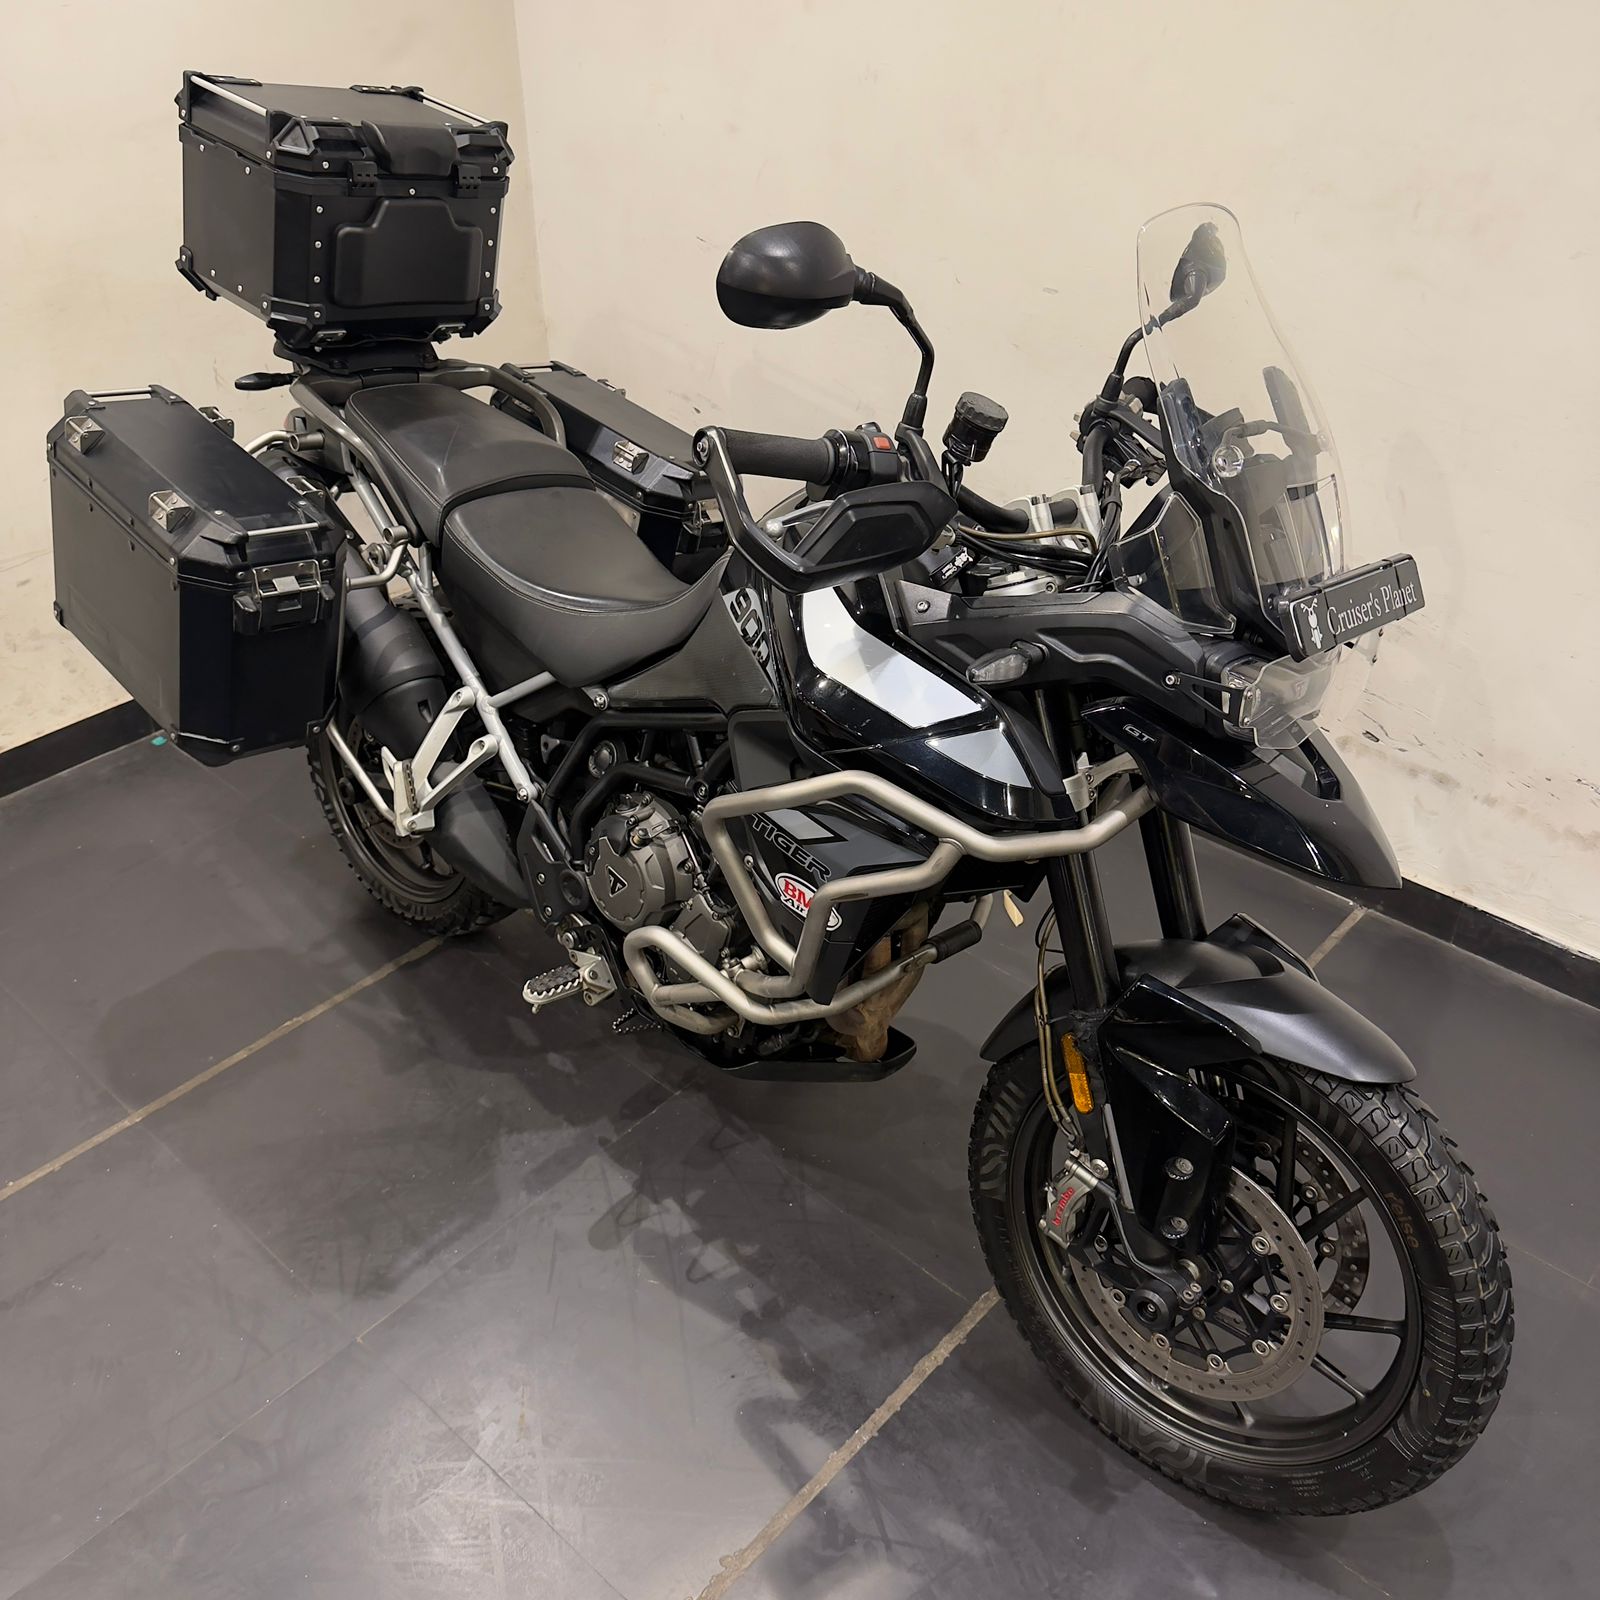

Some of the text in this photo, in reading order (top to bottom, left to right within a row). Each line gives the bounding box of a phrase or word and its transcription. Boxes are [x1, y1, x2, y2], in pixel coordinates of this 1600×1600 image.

[1326, 581, 1418, 636] Cruiser's Planet
[1123, 724, 1156, 742] GT
[751, 812, 832, 884] TIGER
[783, 878, 814, 910] BM
[784, 897, 806, 914] Air
[1051, 1187, 1075, 1227] brembo
